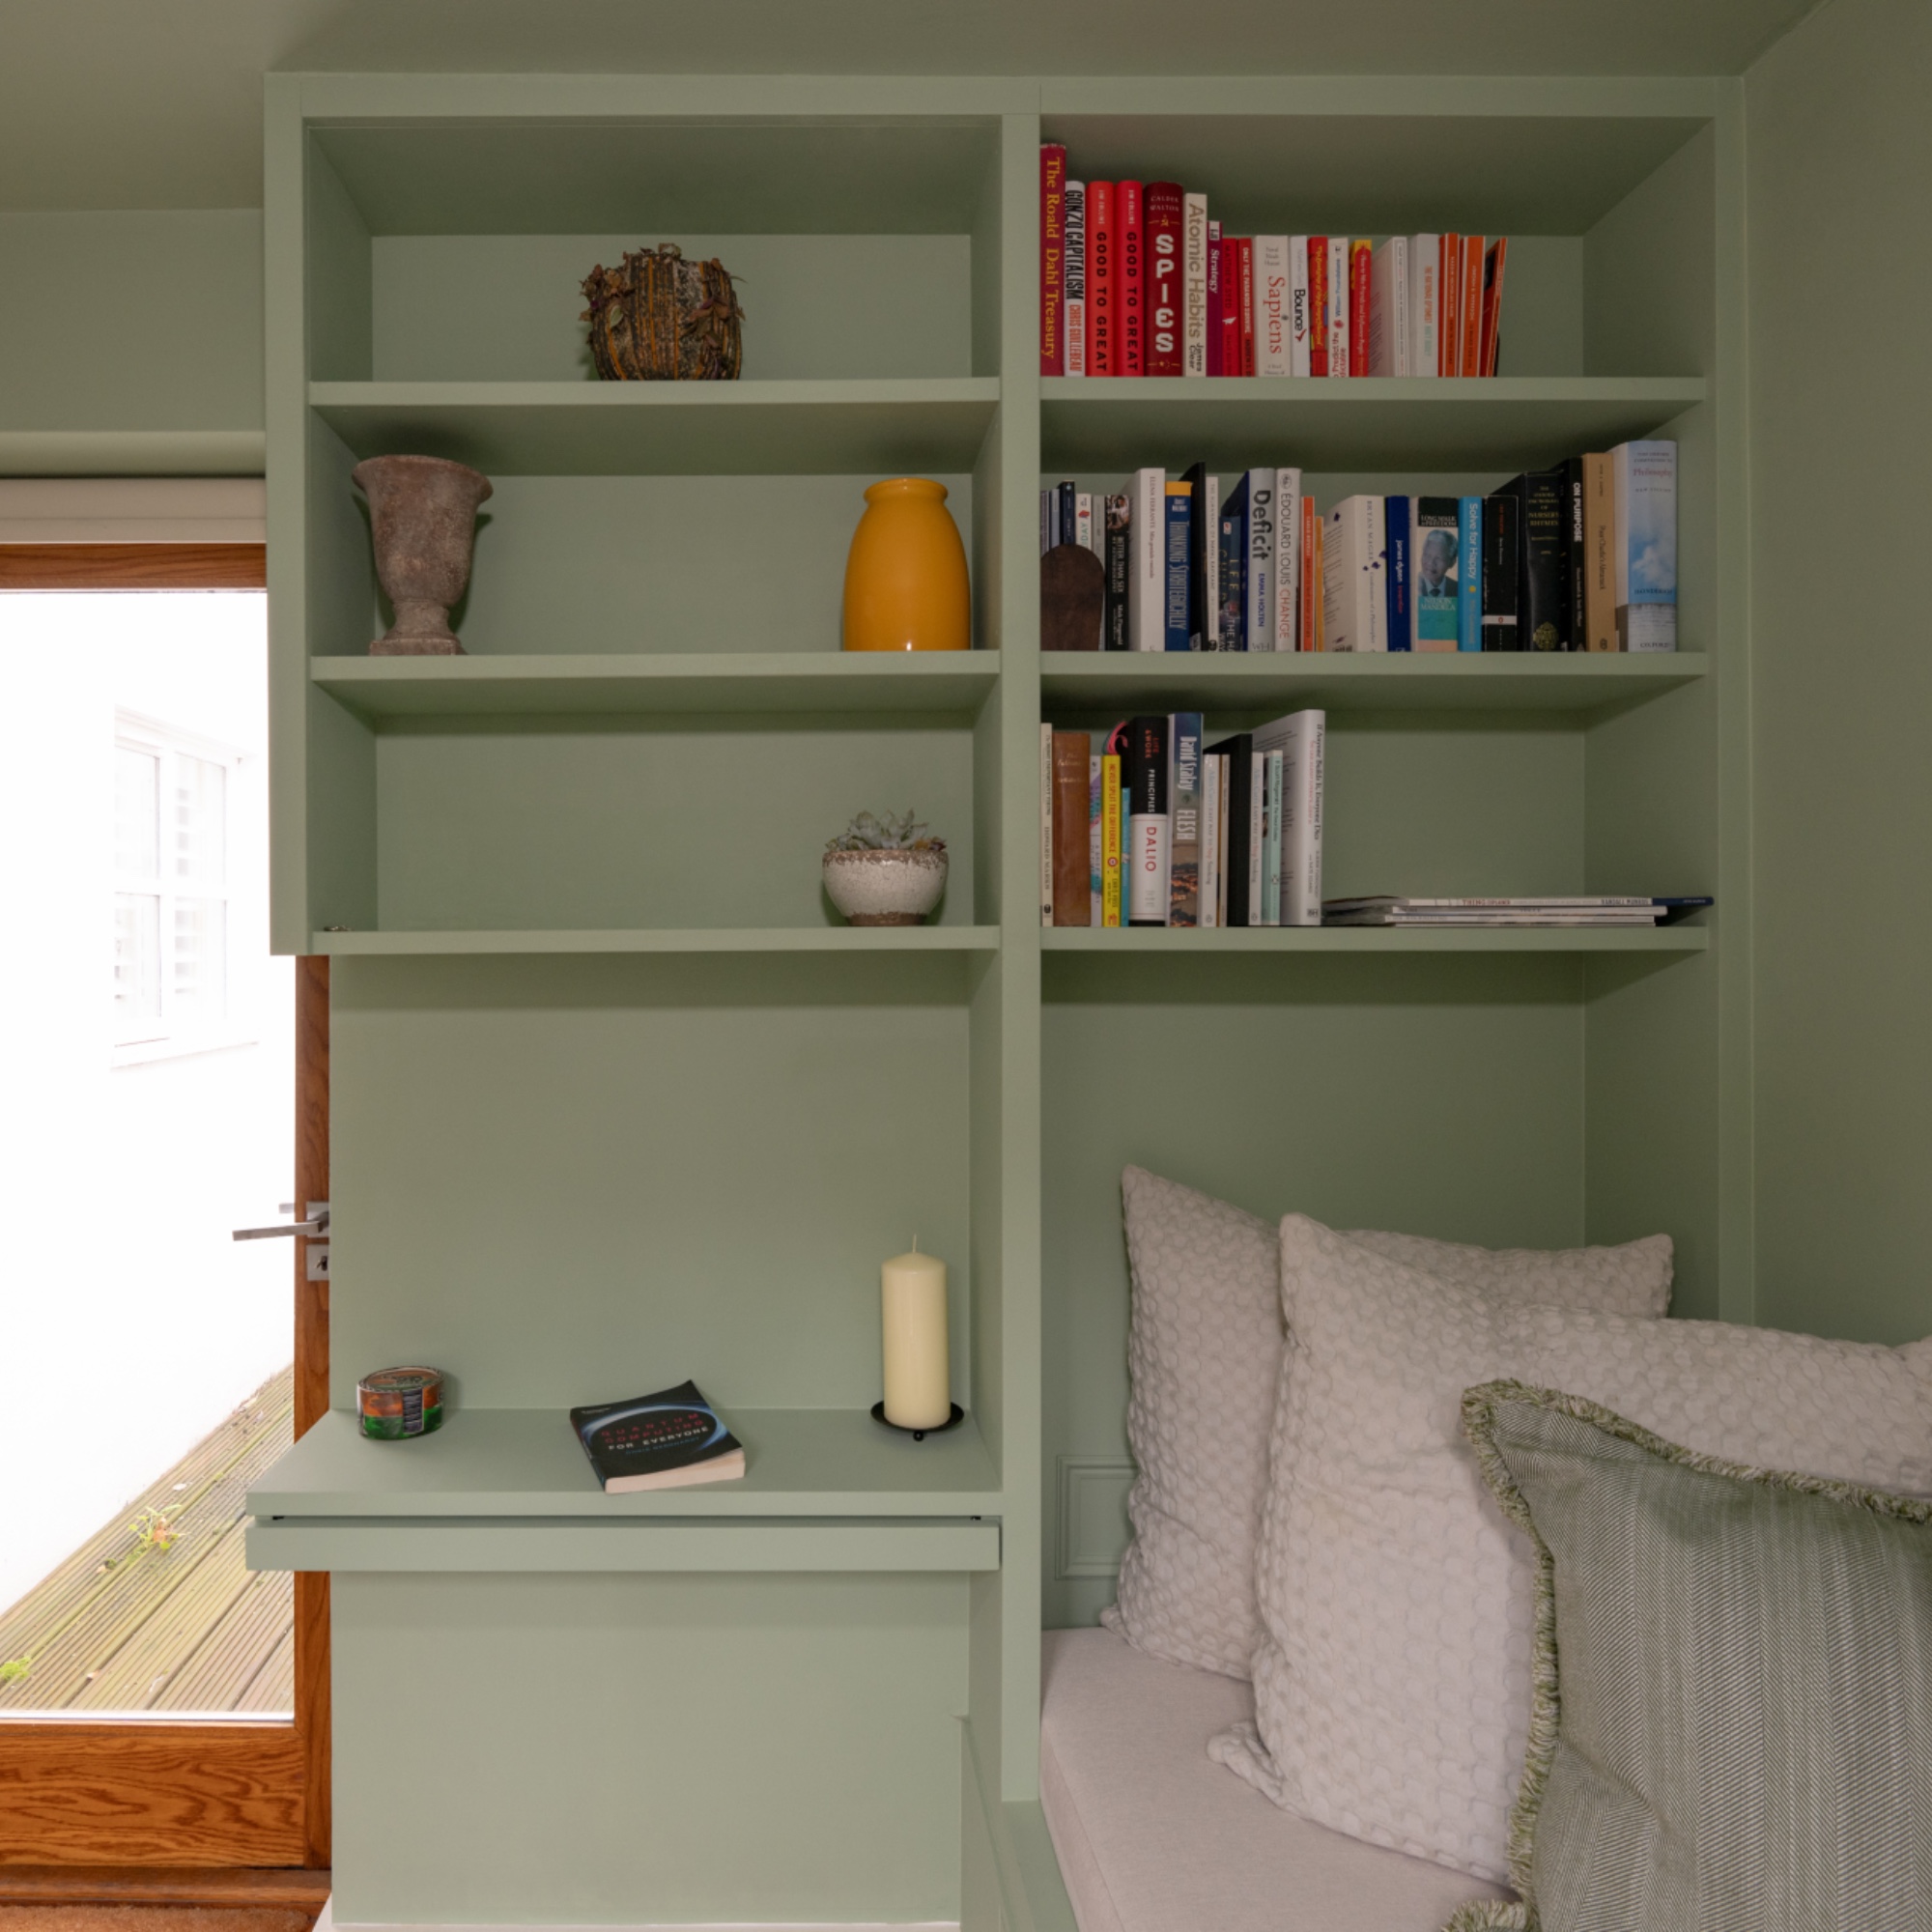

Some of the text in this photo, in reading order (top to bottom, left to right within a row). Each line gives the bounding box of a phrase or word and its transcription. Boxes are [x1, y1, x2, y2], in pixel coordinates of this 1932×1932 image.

[1041, 156, 1061, 358] The Roald Dahl Treasury
[1065, 190, 1084, 300] GONZO CAPITALISM
[1155, 234, 1175, 353] SPIES
[1188, 203, 1204, 338] Atomic Habits
[1209, 249, 1219, 294] Strategy
[1069, 304, 1082, 327] CHRIS
[1097, 232, 1107, 371] GOOD TO GREAT
[1127, 232, 1137, 371] GOOD TO GREAT
[1264, 276, 1285, 354] Sapiens
[1294, 289, 1306, 331] Bounce
[1574, 483, 1581, 497] ON
[1634, 468, 1673, 478] Philosophy
[1169, 521, 1189, 562] THINKING
[1253, 490, 1272, 560] Deficit
[1280, 494, 1293, 585] ÉDOUARD LOUIS
[1468, 502, 1478, 580] Solve for Happy
[1229, 559, 1238, 590] LEE
[1395, 561, 1404, 582] dyson
[1169, 564, 1189, 630] STRATEGICALLY
[1279, 588, 1291, 639] CHANGE
[1179, 736, 1198, 790] David Szalay
[1177, 810, 1196, 840] FLESH
[1146, 827, 1157, 872] DALIO
[601, 1413, 699, 1436] QUANTUM
[605, 1420, 704, 1444] COMPUTING
[608, 1426, 709, 1451] FOR EVERYONE
